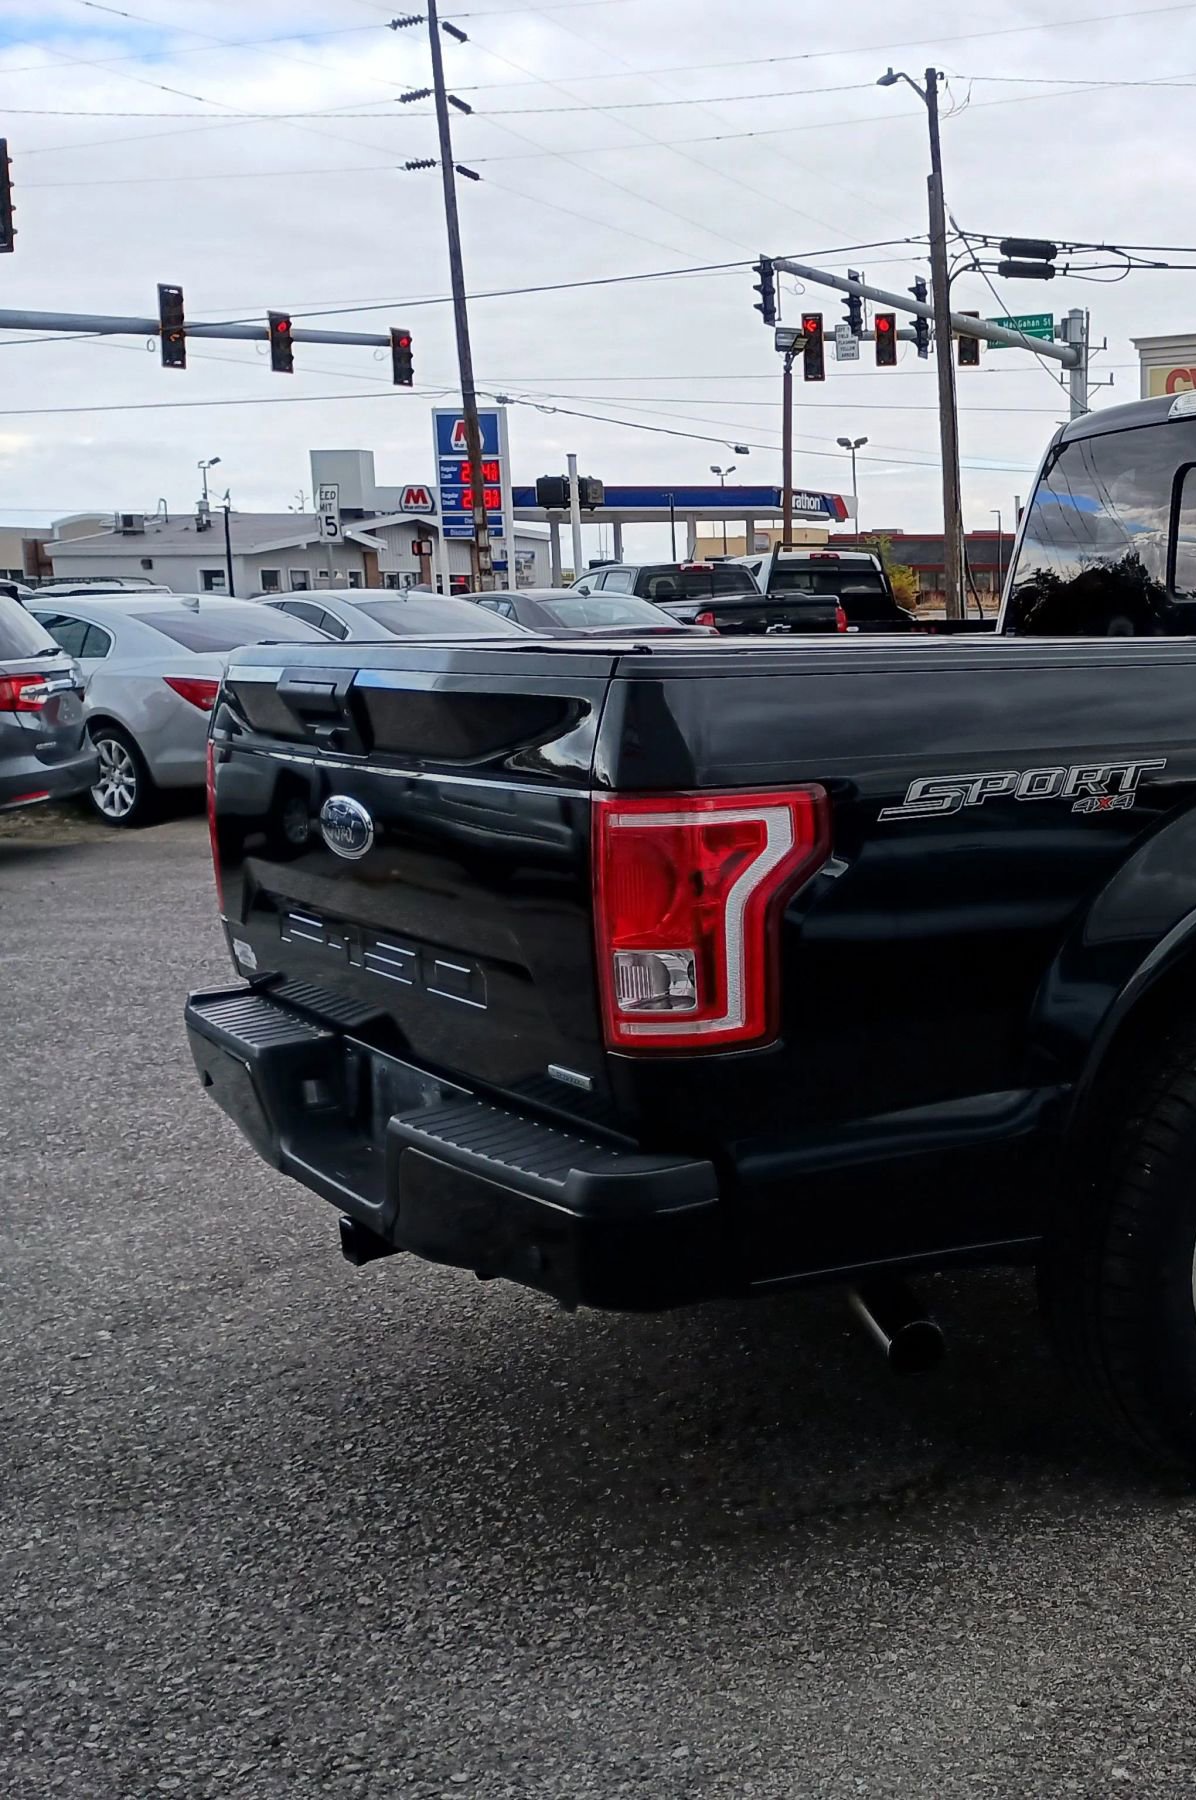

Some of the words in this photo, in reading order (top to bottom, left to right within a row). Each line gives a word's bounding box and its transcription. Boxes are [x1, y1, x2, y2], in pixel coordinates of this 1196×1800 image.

[1043, 317, 1051, 327] St
[320, 490, 336, 501] EED
[320, 503, 332, 512] MIT
[877, 758, 1167, 822] SPORT
